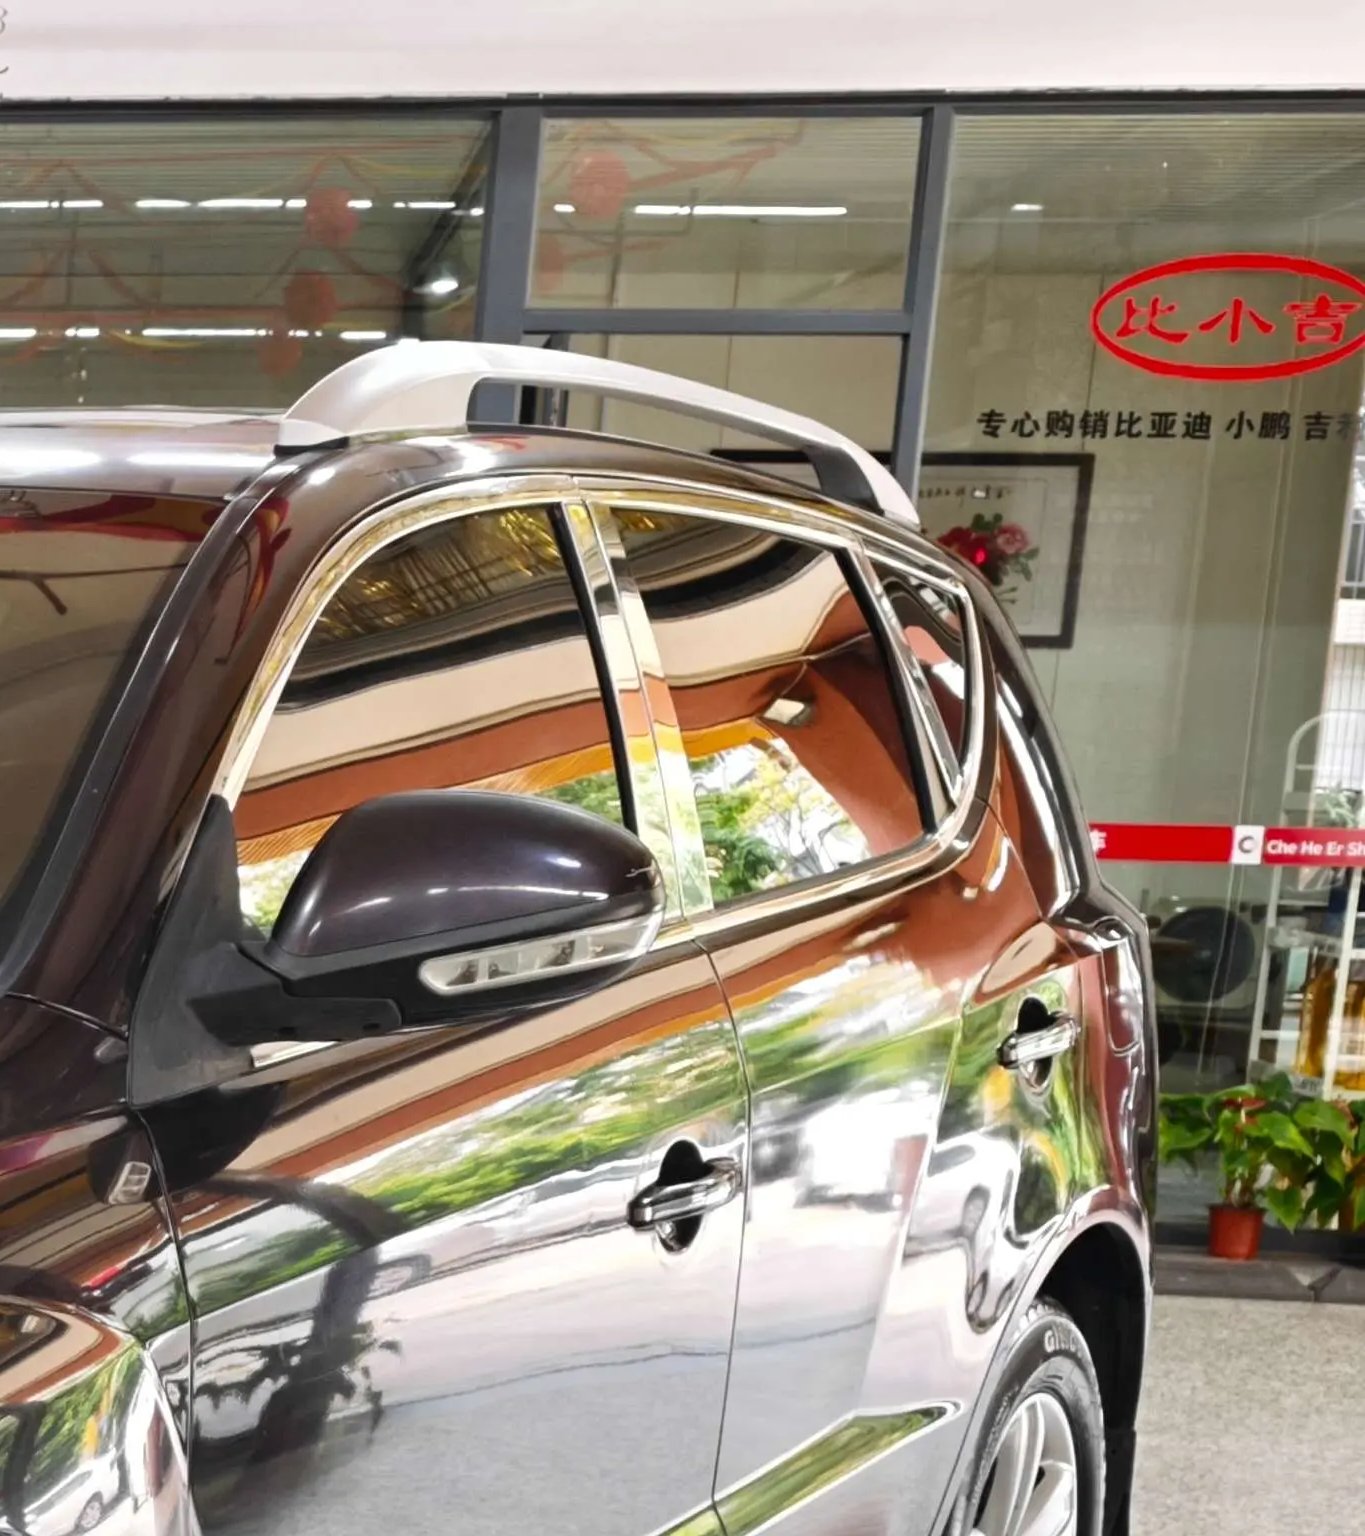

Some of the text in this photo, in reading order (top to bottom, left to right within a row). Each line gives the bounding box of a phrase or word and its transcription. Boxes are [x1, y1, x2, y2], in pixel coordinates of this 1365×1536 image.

[1115, 293, 1363, 345] 比小吉
[977, 408, 1212, 439] 专心购销比亚迪
[1225, 410, 1291, 440] 小鹏
[1267, 839, 1298, 856] Che
[1300, 840, 1323, 856] He
[1326, 841, 1344, 856] Er
